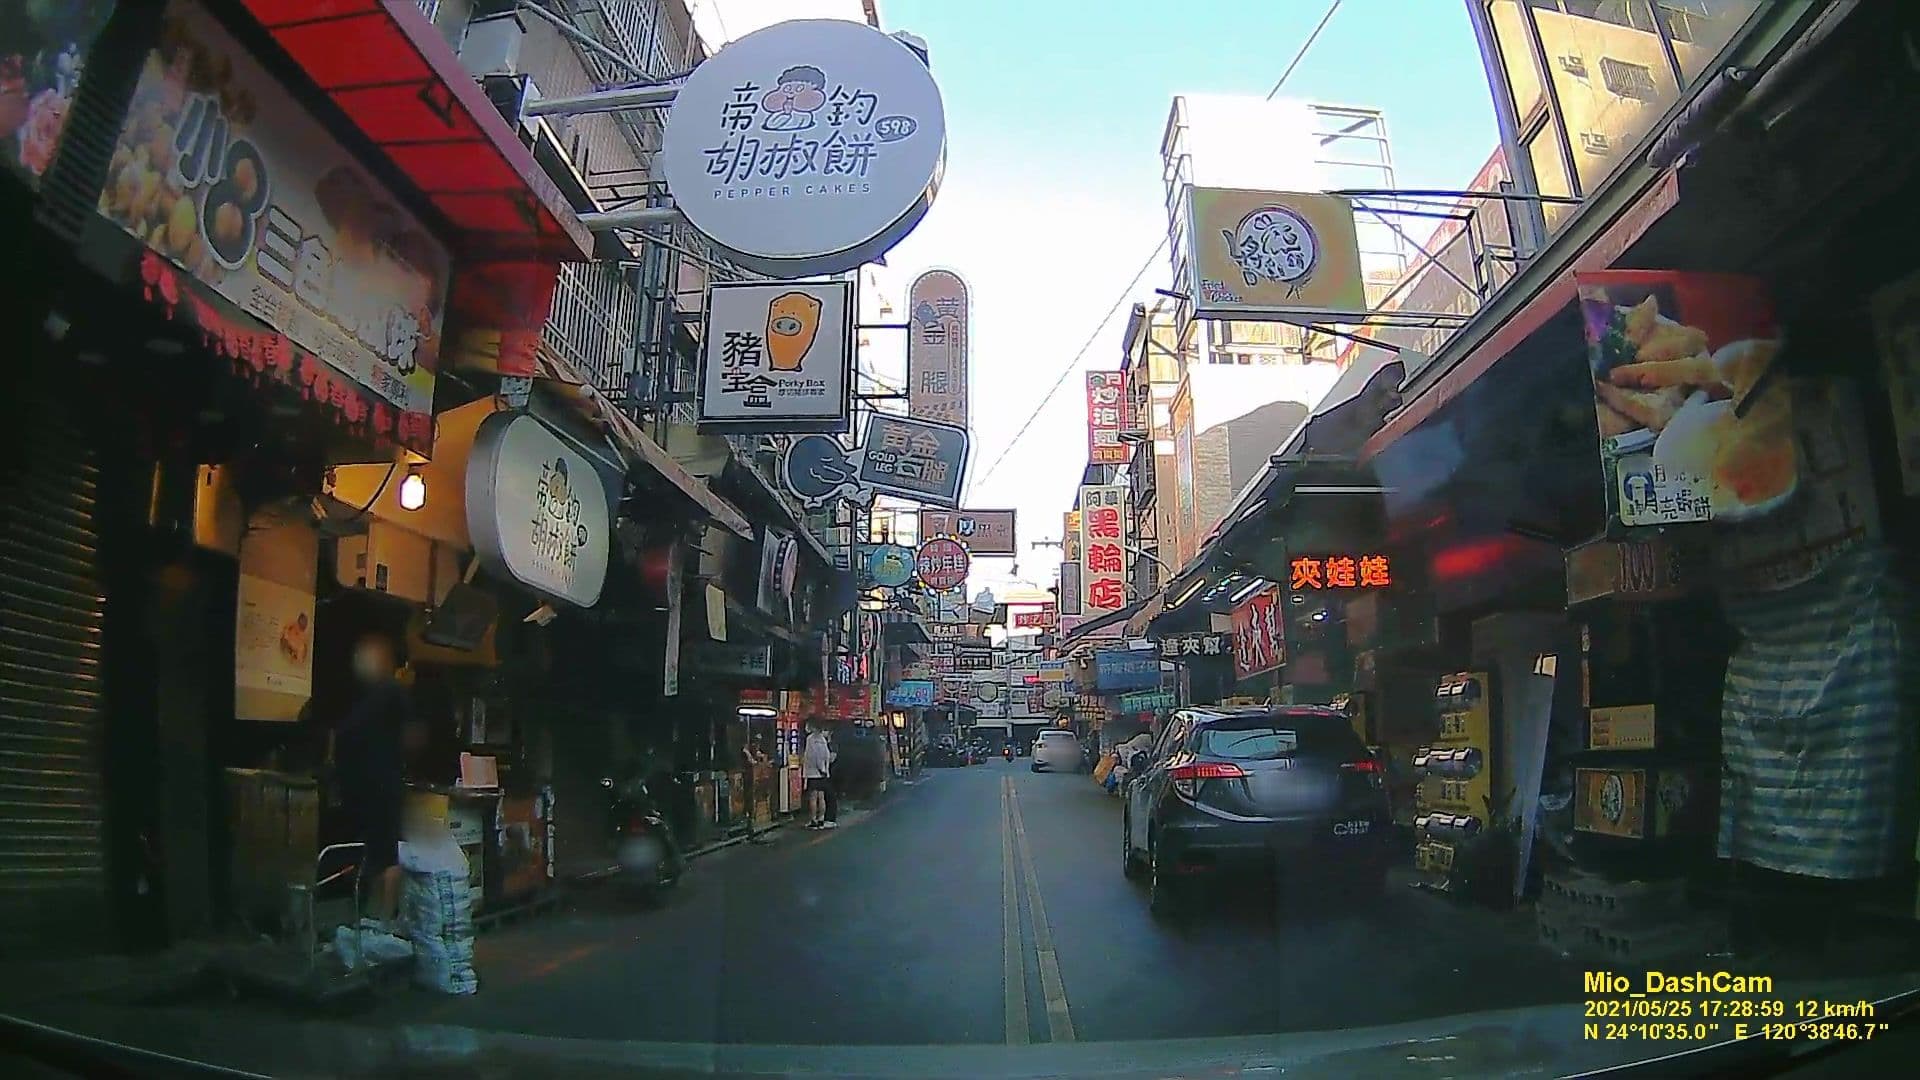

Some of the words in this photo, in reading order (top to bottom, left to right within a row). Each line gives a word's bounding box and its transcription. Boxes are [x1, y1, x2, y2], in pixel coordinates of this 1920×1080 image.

[879, 120, 911, 135] 598
[704, 130, 877, 184] 胡椒餅
[714, 186, 790, 199] PEPPER
[805, 183, 871, 195] CAKES
[778, 379, 805, 389] Porky
[806, 379, 826, 388] Box
[881, 422, 941, 459] 黃金
[868, 450, 897, 463] GOLD
[874, 462, 894, 474] LEG
[1088, 508, 1122, 609] 黑輪店
[1290, 555, 1391, 590] 夾娃娃
